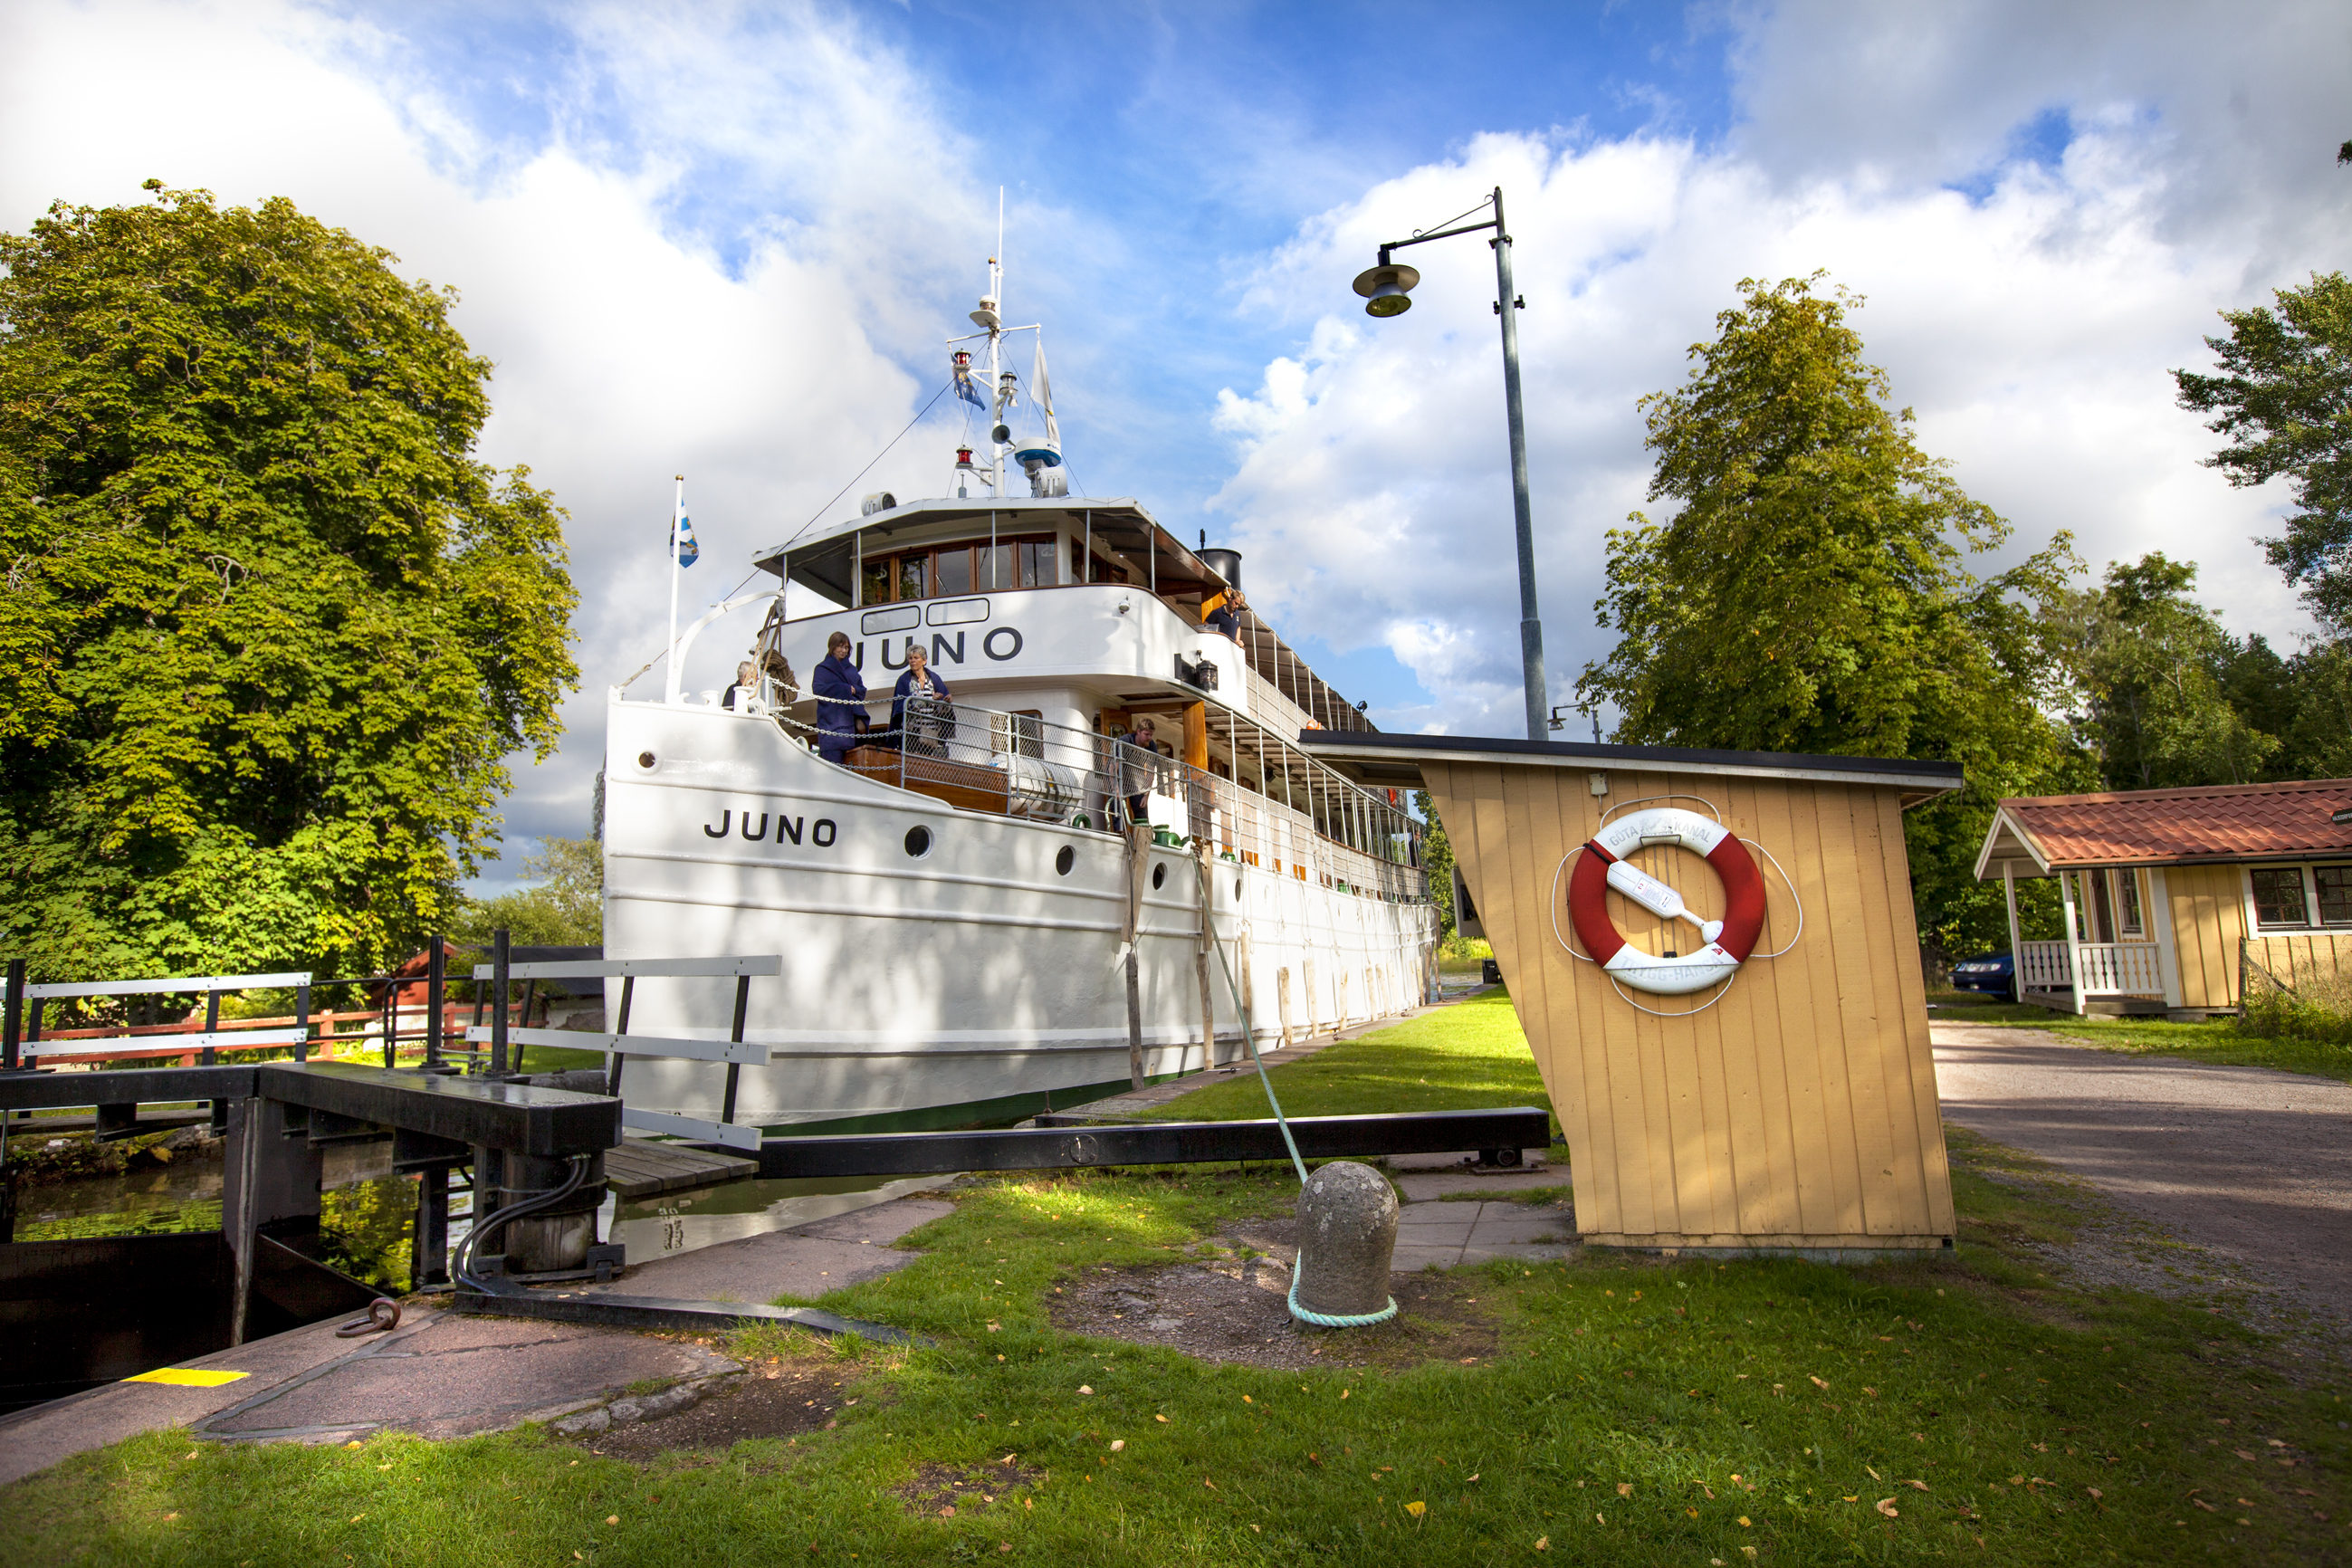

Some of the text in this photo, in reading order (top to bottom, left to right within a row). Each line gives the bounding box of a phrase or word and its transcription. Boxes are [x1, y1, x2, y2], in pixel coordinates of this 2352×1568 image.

[704, 809, 837, 847] JUNO
[1609, 821, 1711, 846] GÖTA KANAL
[1620, 954, 1725, 980] TRYGG-HANSA
